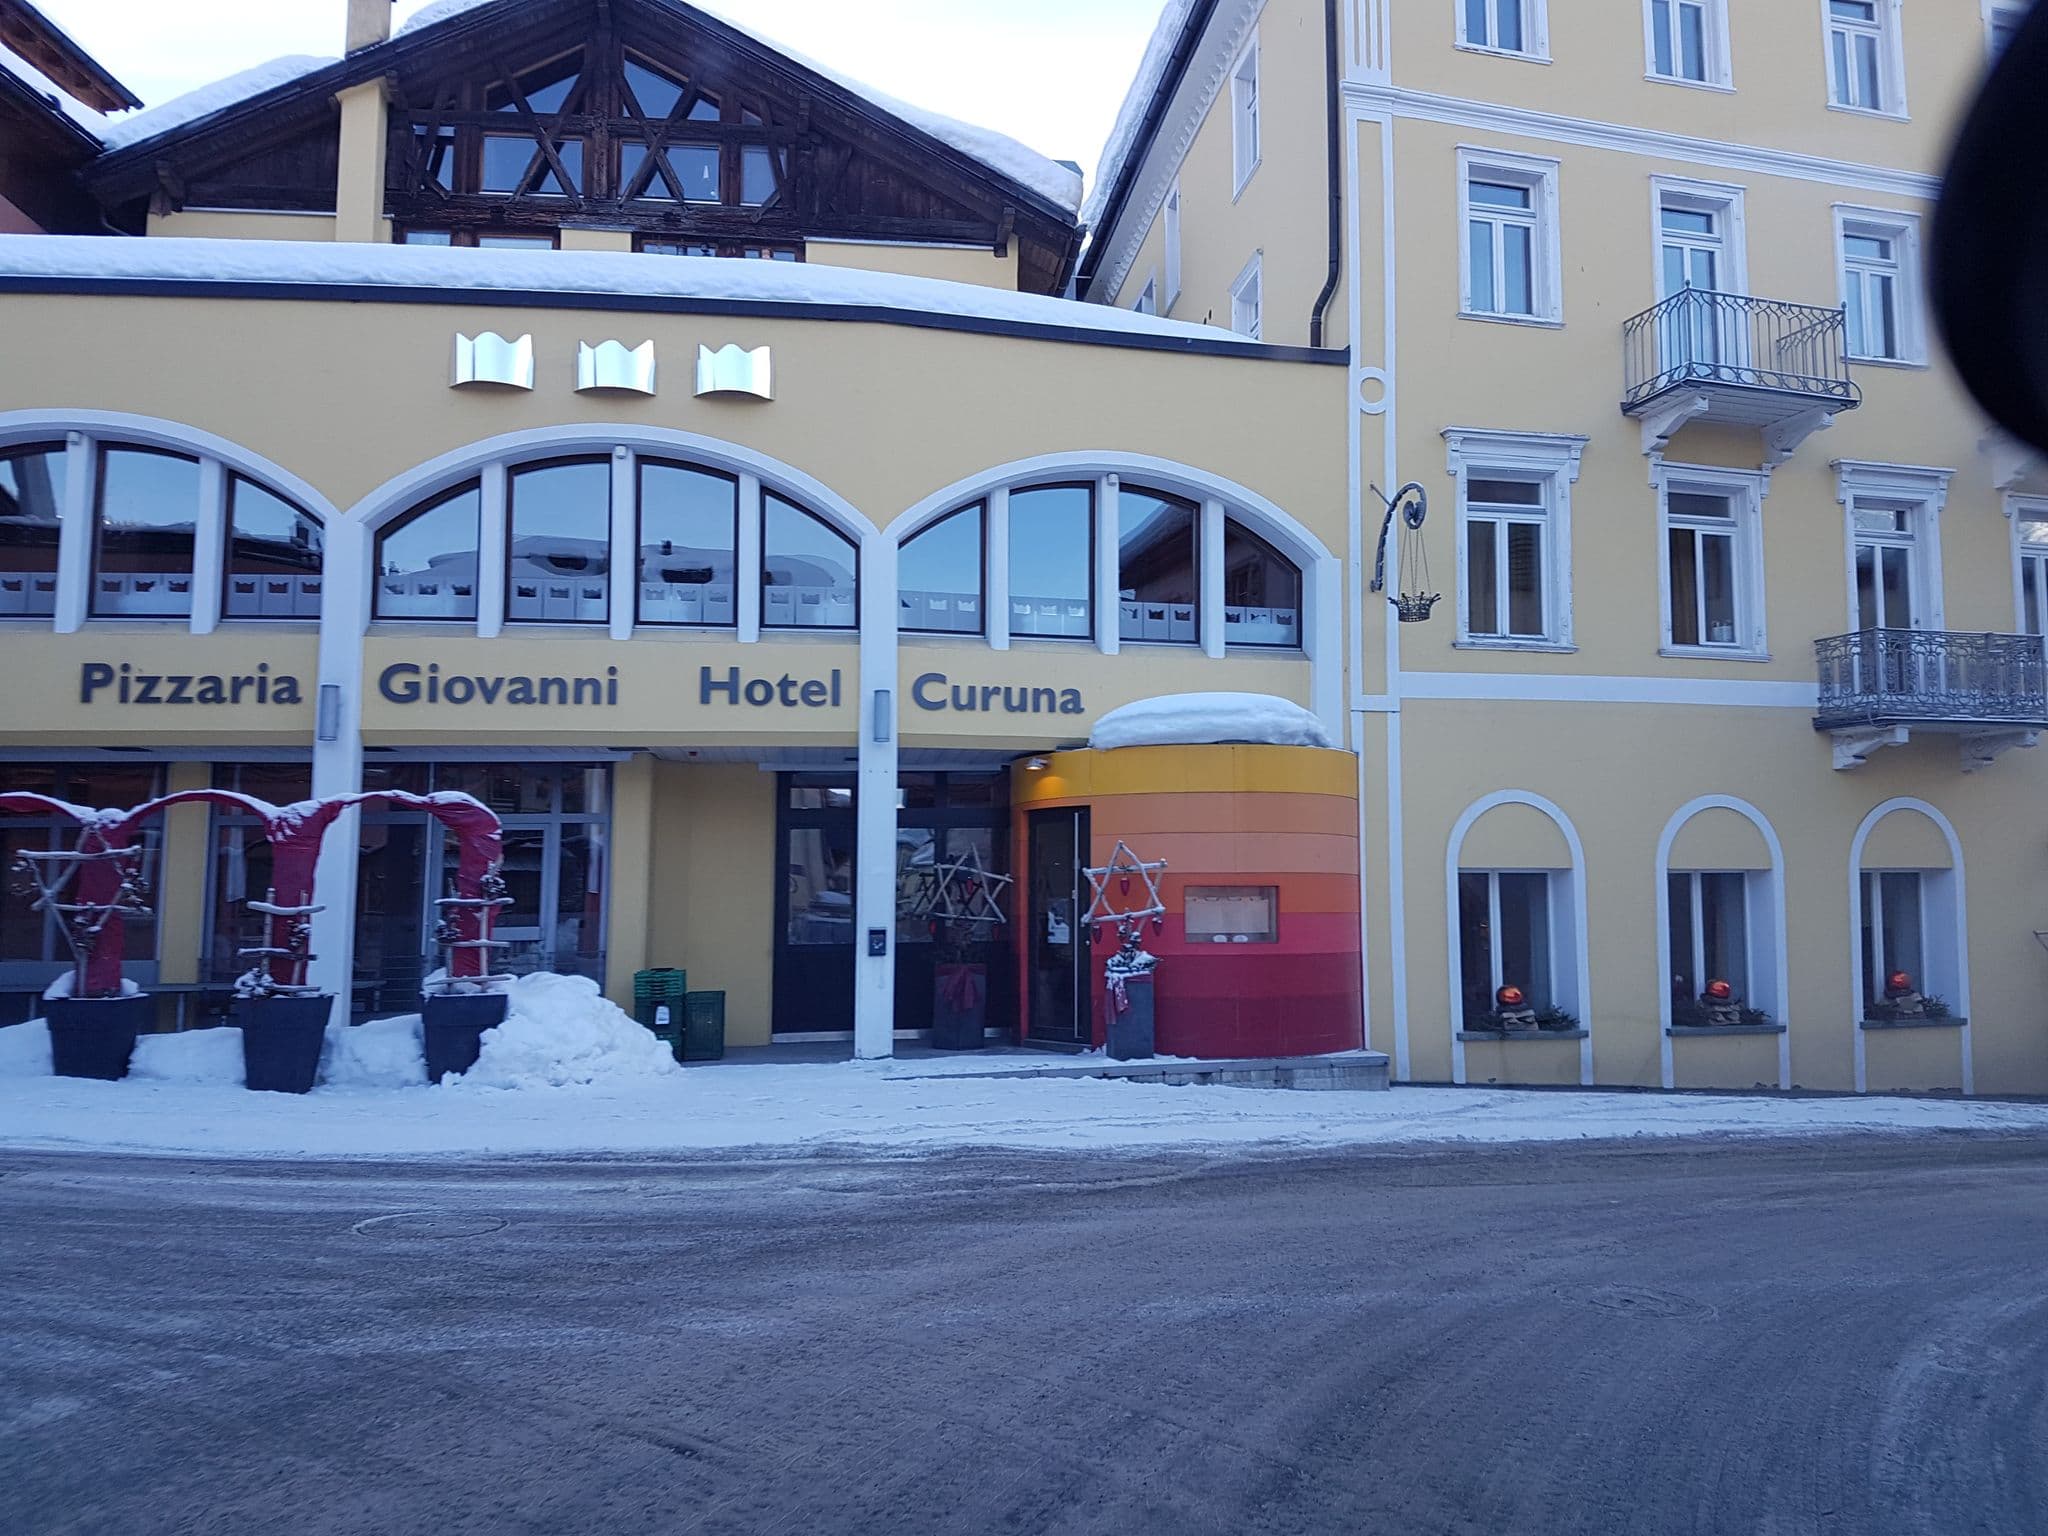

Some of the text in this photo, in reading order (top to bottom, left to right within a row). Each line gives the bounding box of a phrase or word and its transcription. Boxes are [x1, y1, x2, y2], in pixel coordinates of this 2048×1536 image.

[80, 662, 1085, 715] Pizzaria Giovanni Hotel Curuna
